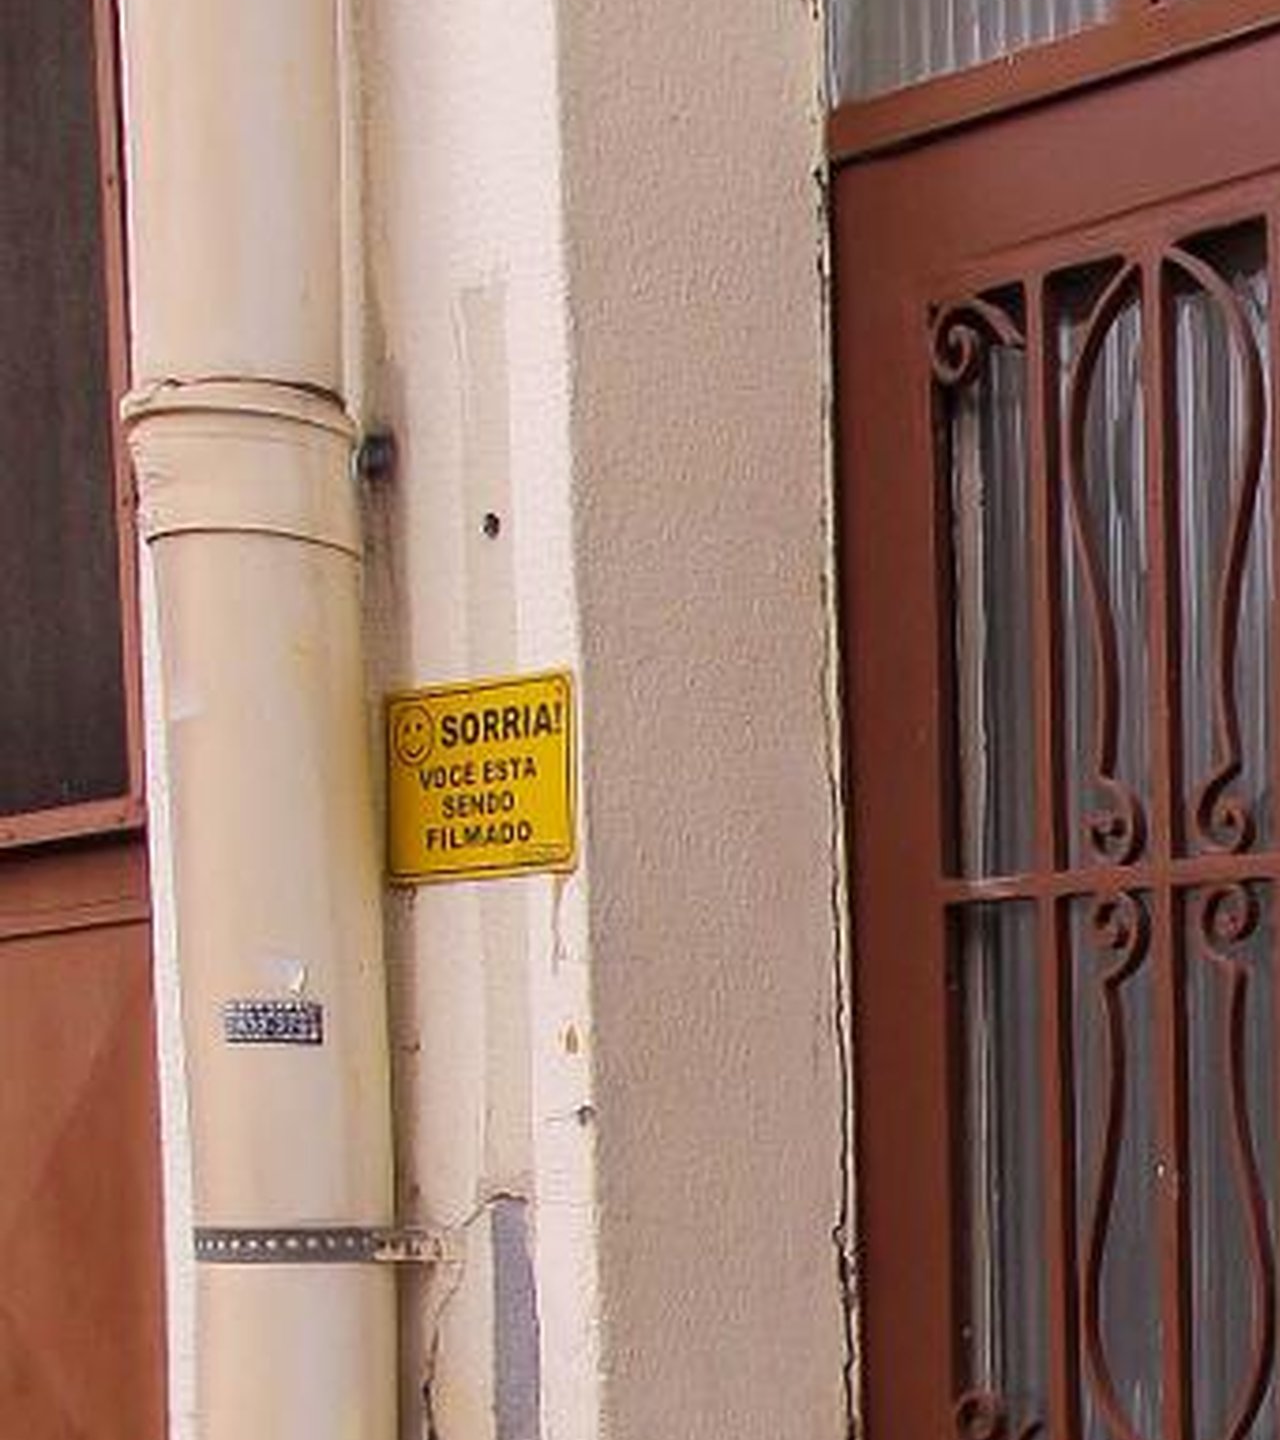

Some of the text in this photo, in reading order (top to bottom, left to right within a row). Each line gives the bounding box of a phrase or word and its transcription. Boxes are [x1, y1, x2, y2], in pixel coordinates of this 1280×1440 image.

[441, 702, 563, 748] SORRIA!
[441, 790, 515, 819] SENDO
[426, 821, 533, 850] FILMADO
